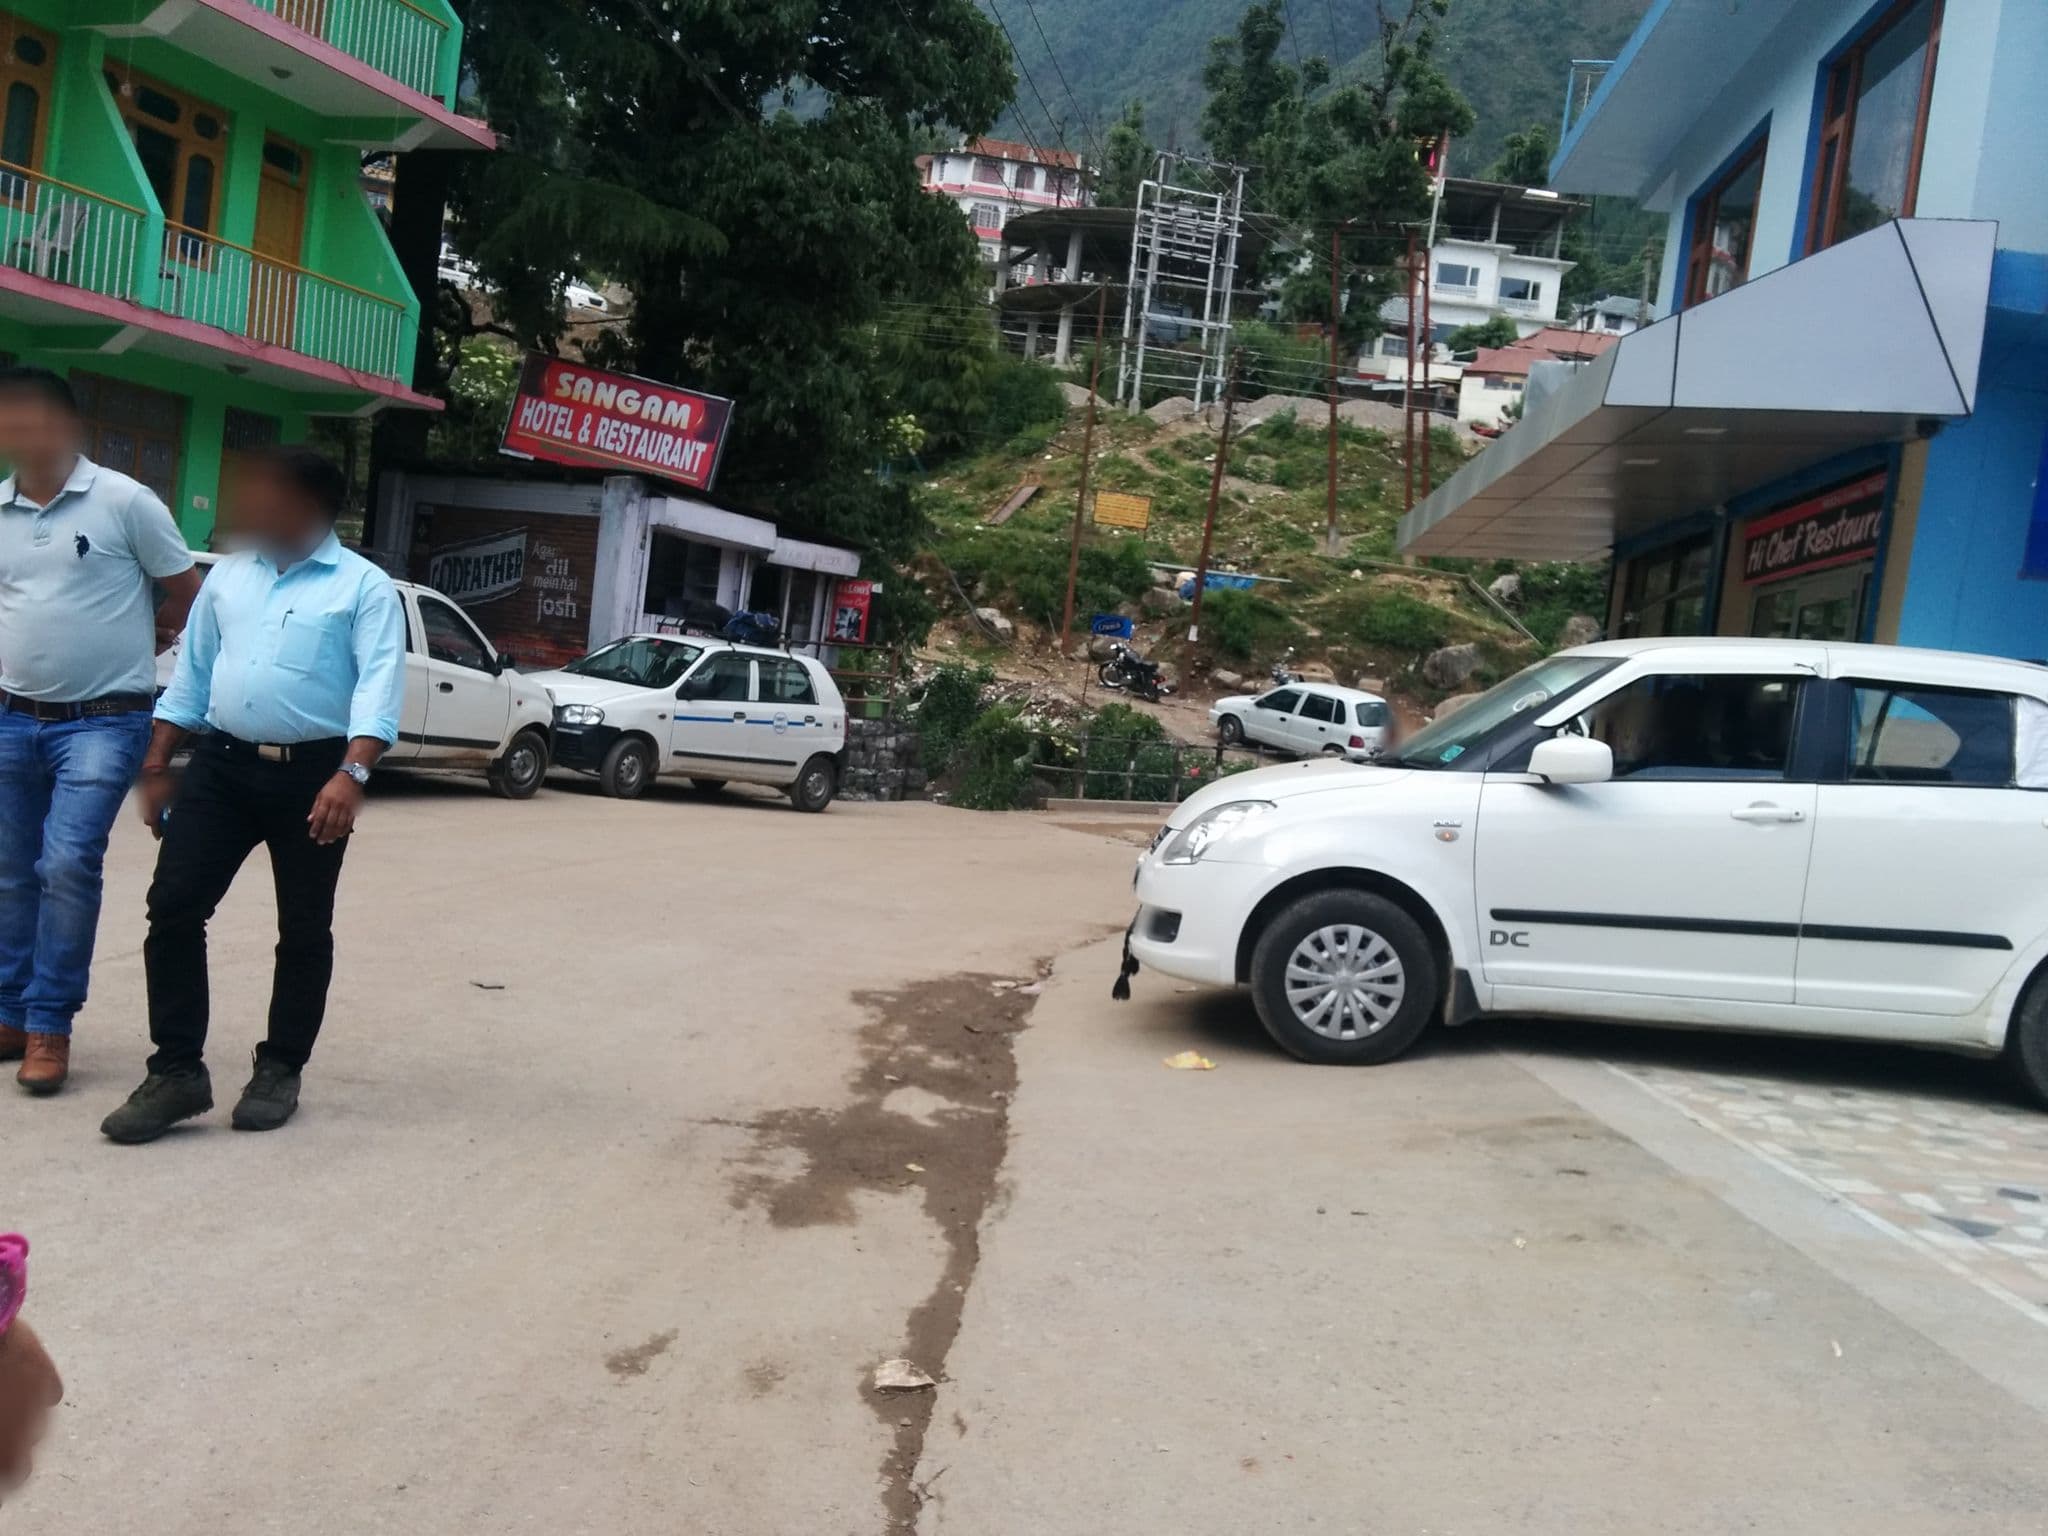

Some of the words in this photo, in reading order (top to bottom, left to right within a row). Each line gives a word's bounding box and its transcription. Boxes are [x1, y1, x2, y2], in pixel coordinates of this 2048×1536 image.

[554, 372, 692, 430] SANGAM
[518, 397, 574, 440] HOTEL
[577, 412, 592, 444] &
[593, 416, 708, 474] RESTAURANT
[1765, 523, 1805, 569] Chef
[545, 558, 569, 577] dil
[537, 591, 577, 624] josh
[1489, 930, 1530, 948] DC
